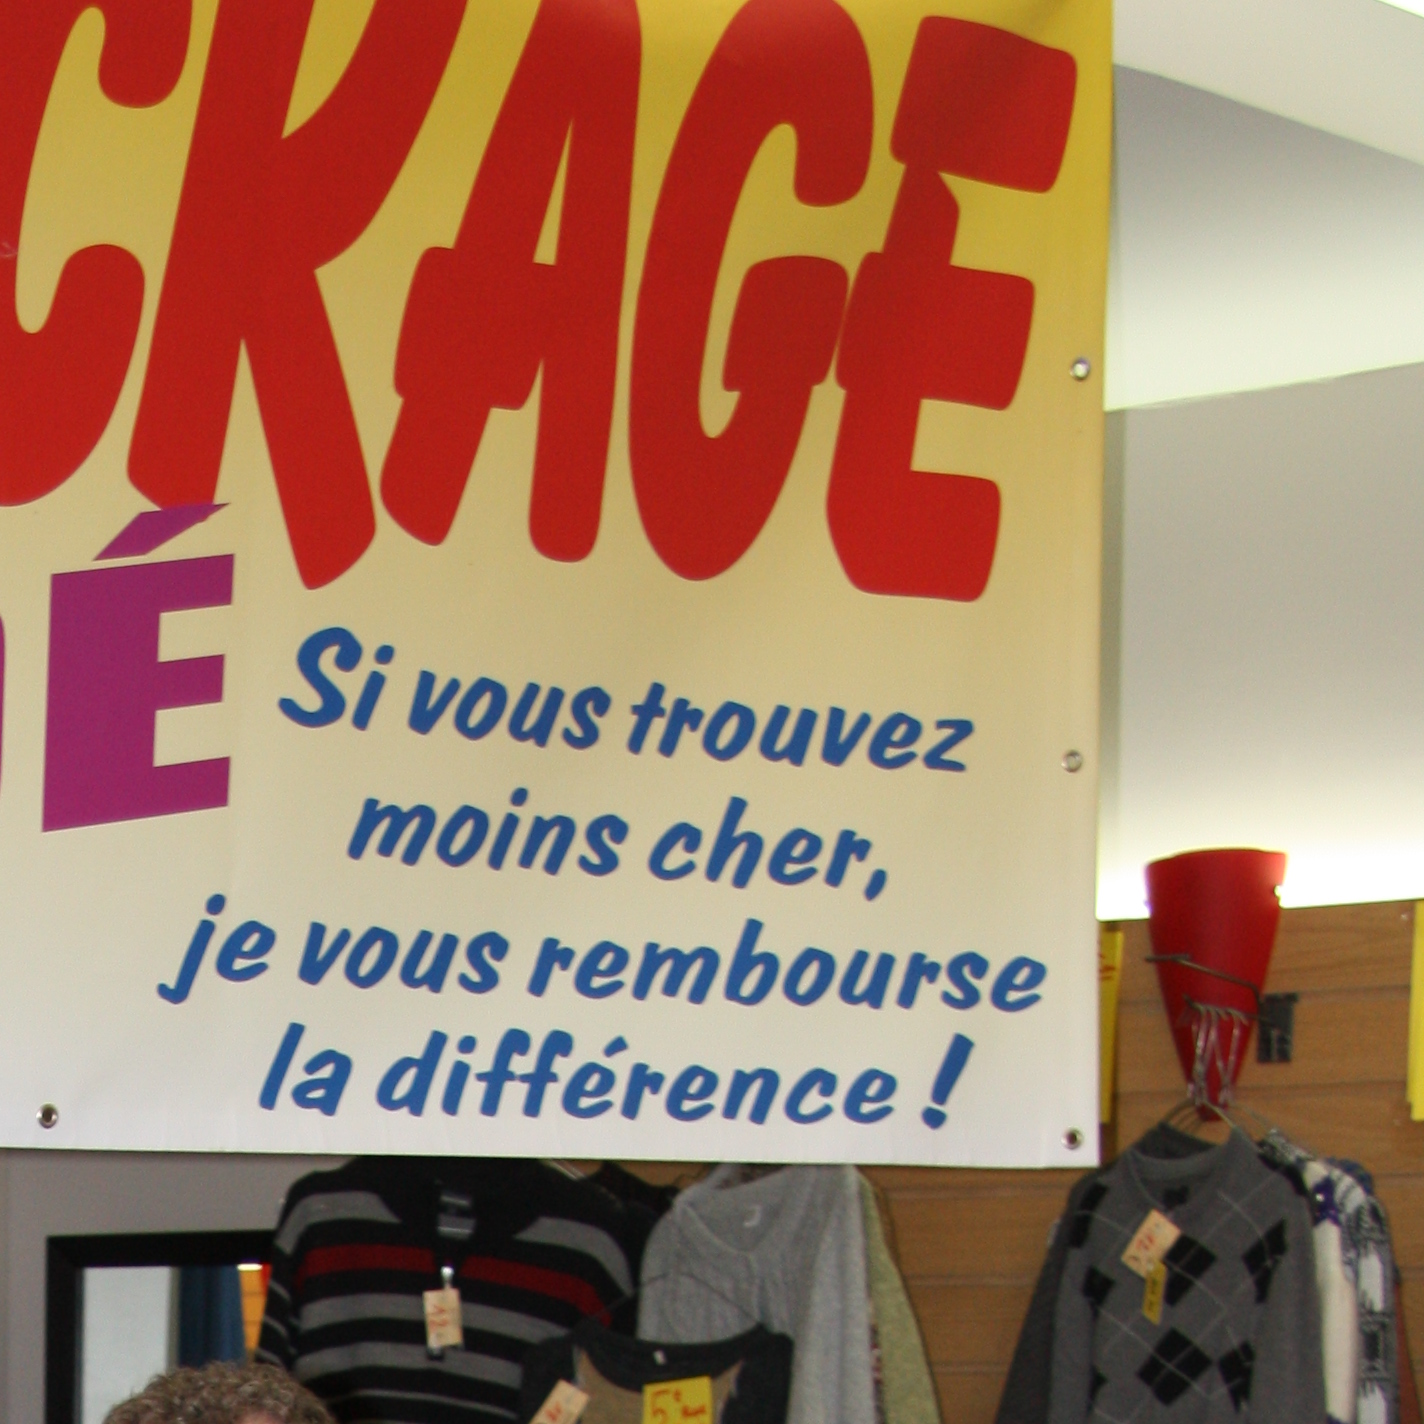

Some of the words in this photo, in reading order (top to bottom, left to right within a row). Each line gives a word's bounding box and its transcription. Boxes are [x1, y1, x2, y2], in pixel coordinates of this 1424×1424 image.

[279, 627, 395, 728] Si
[409, 670, 611, 747] vous
[629, 682, 974, 770] trouvez
[347, 788, 629, 876] moins
[649, 797, 887, 899] cher,
[157, 893, 277, 1003] je
[298, 921, 509, 993] vous
[528, 919, 1047, 1011] rembourse
[259, 1022, 353, 1116] la
[376, 1029, 897, 1124] différence
